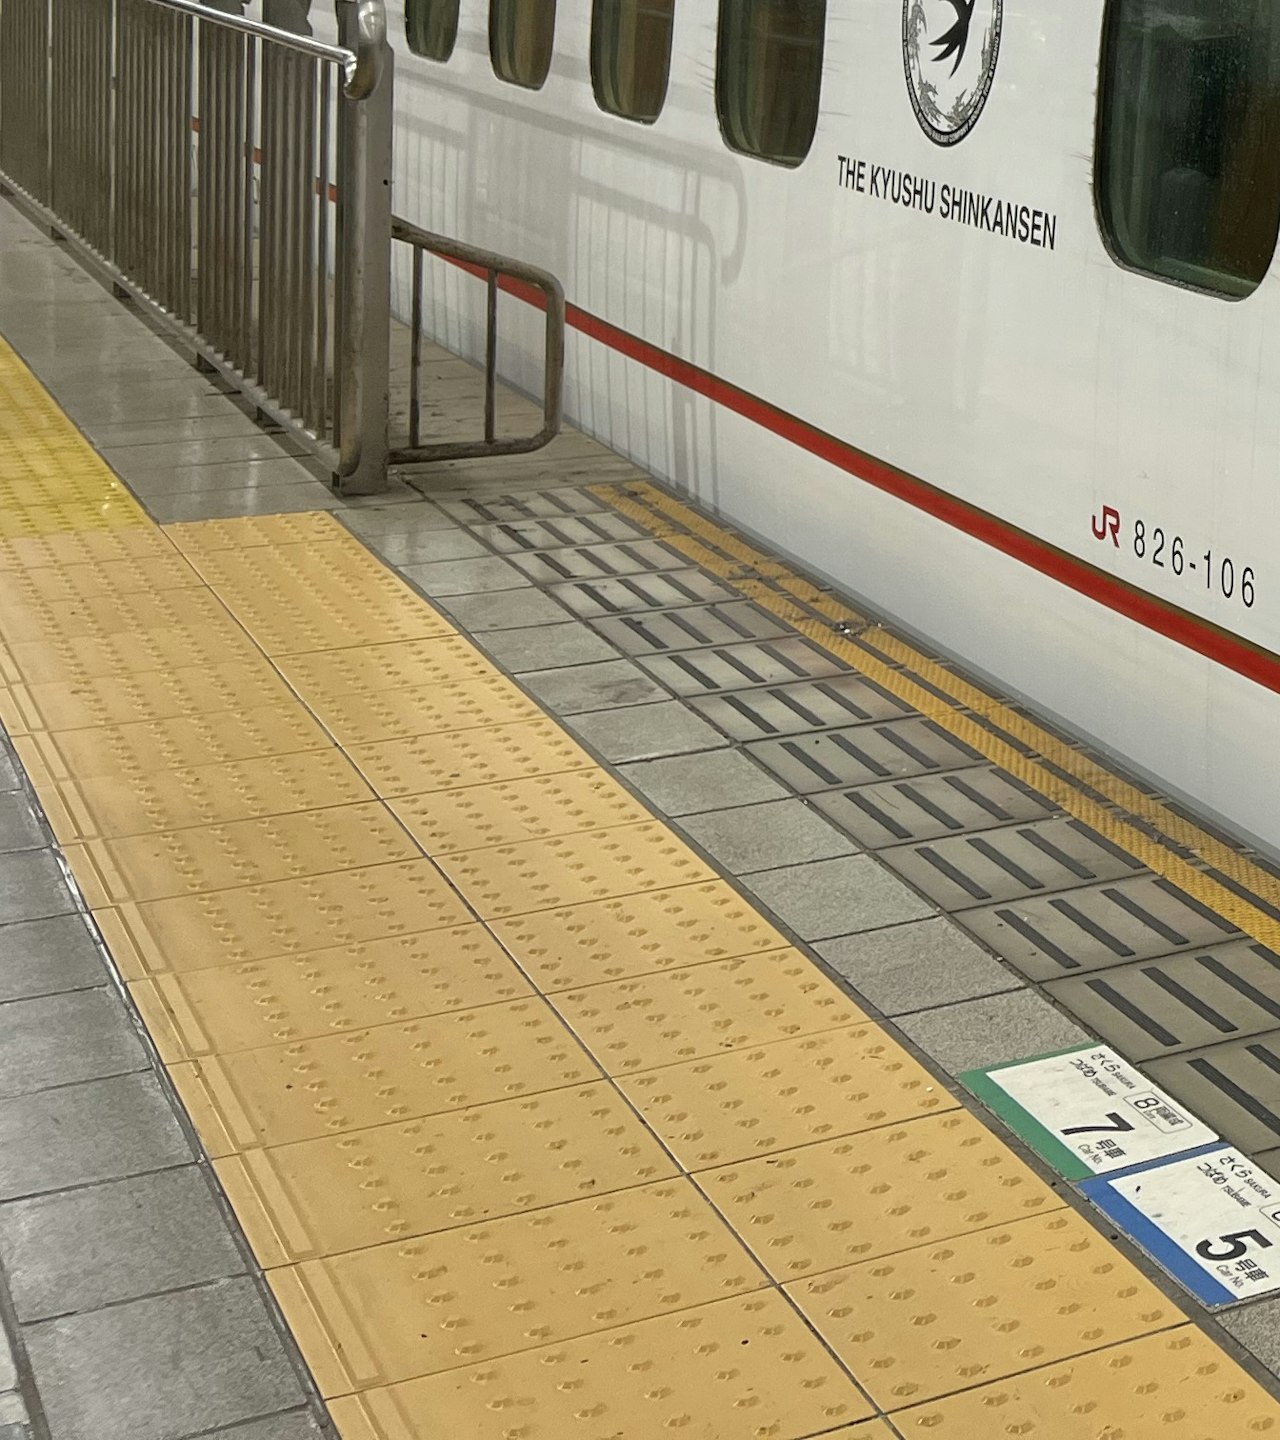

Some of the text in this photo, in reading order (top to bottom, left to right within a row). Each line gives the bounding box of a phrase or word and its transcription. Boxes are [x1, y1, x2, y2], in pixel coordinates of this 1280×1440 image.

[838, 155, 1056, 250] THE KYUSHU SHINKANSEN
[1092, 505, 1254, 608] JR 826-106
[1091, 1053, 1121, 1074] さくら
[1134, 1097, 1160, 1109] 8
[1060, 1112, 1135, 1136] 7
[1219, 1155, 1252, 1177] さくら
[1195, 1228, 1274, 1282] 5 号車
